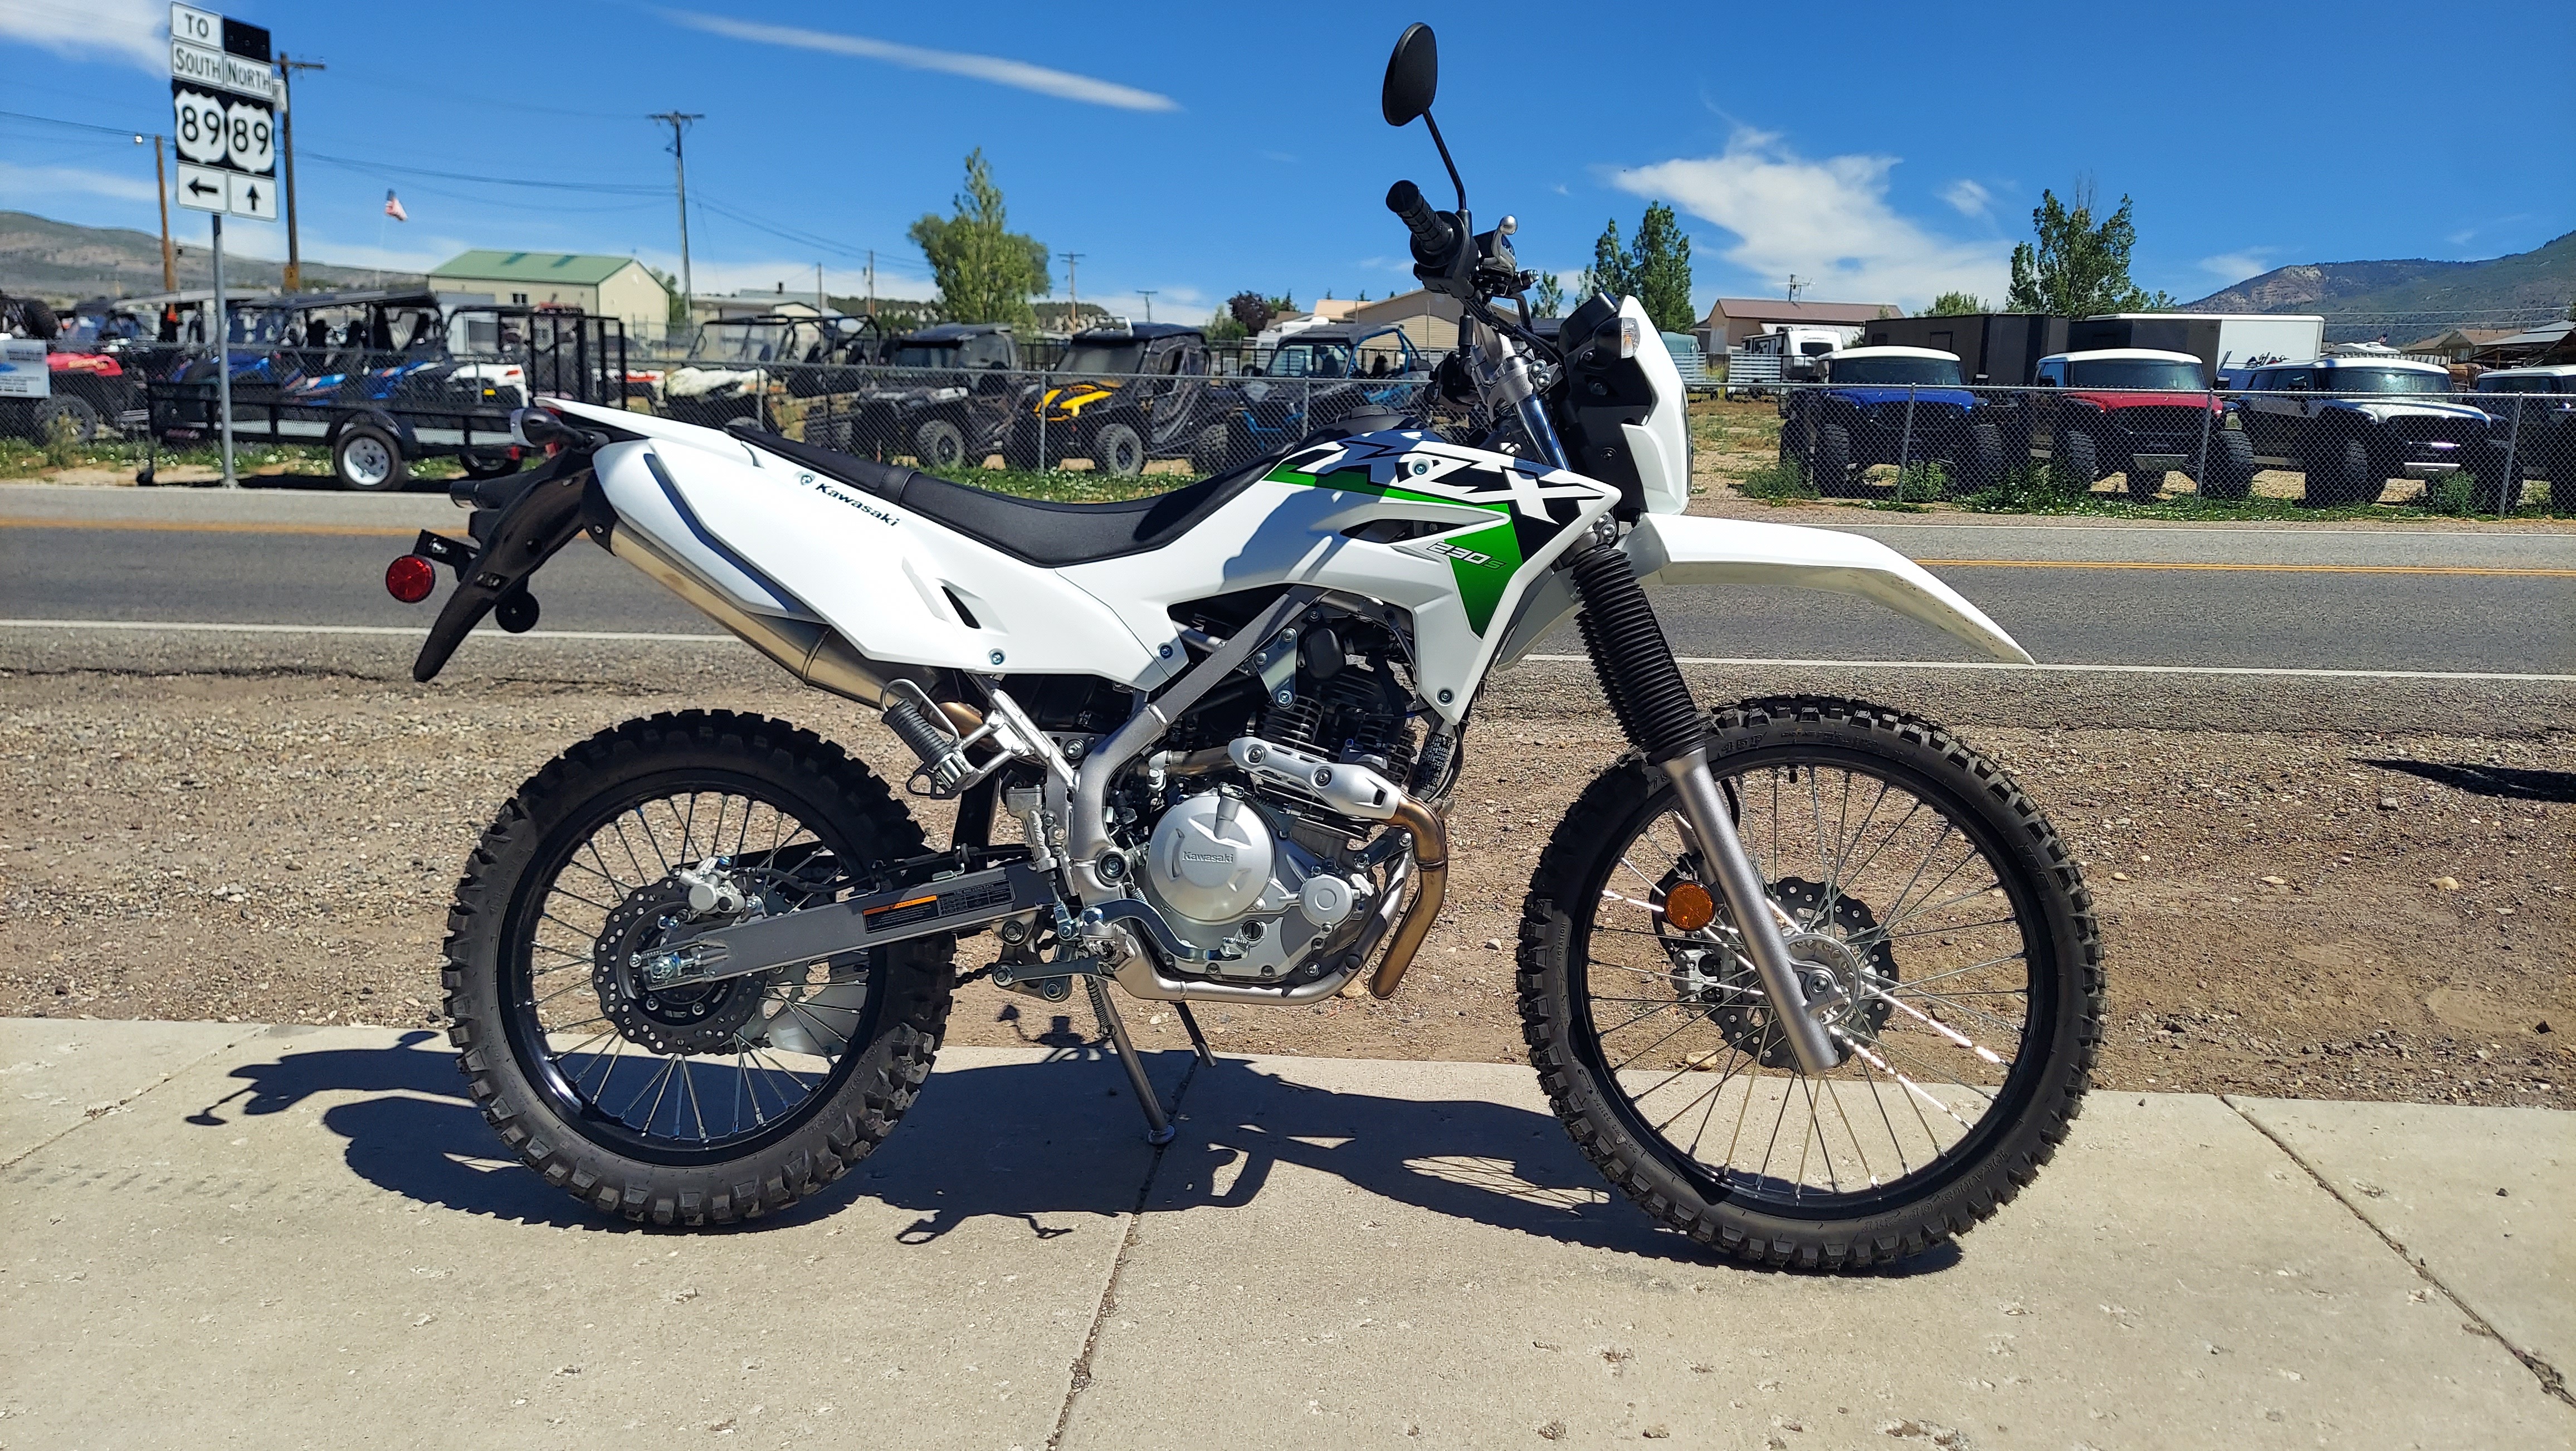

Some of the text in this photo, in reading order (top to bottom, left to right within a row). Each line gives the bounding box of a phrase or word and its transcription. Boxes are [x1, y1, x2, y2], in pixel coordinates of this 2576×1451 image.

[186, 13, 208, 37] TO
[176, 48, 221, 79] SOUTH
[228, 61, 271, 90] NORTH
[183, 106, 219, 145] 89
[234, 119, 268, 154] 89
[816, 484, 900, 526] Kawasaki
[1182, 851, 1233, 863] Kawasaki
[1557, 923, 1567, 961] ROTATION
